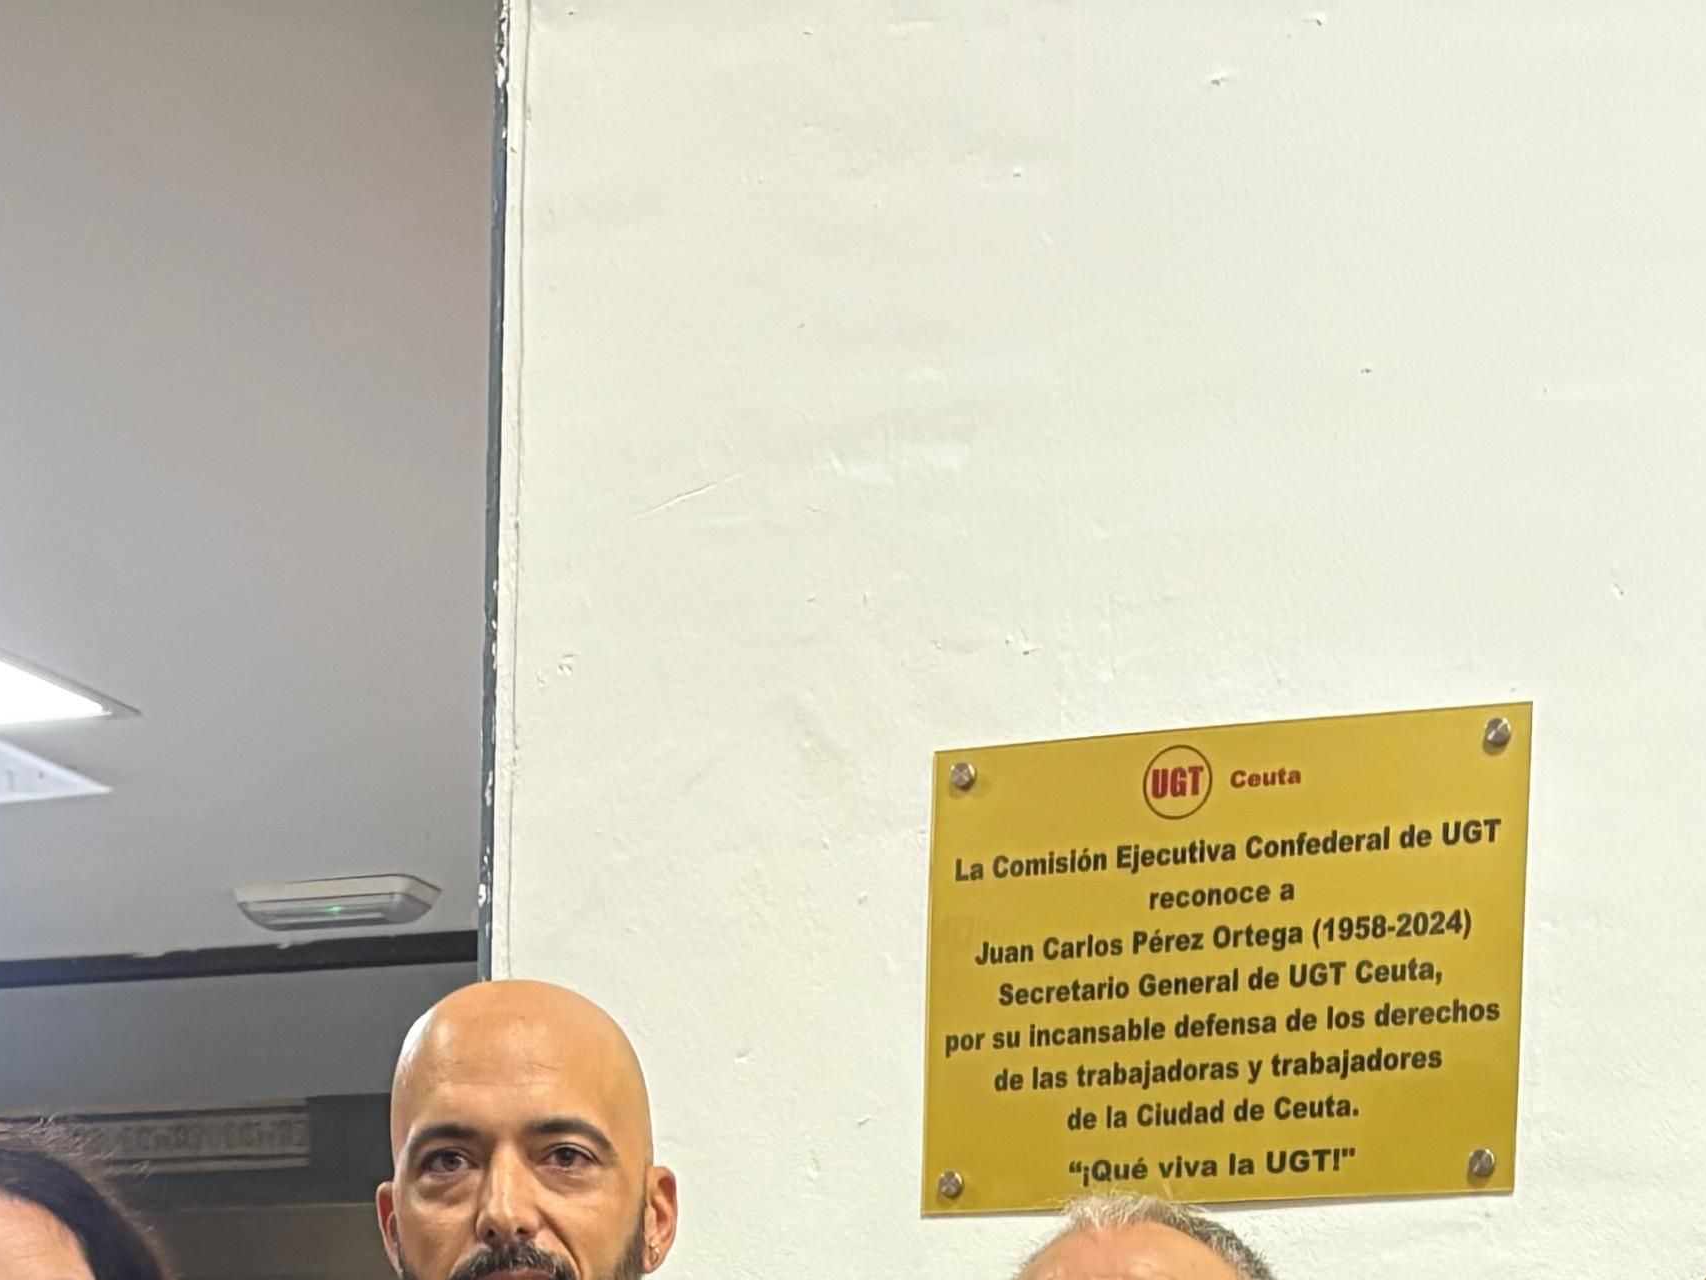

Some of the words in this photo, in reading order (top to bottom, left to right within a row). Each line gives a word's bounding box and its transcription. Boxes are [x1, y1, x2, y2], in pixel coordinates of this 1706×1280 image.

[1150, 766, 1203, 800] UGT
[1230, 767, 1301, 789] Ceuta
[955, 858, 983, 881] La
[993, 848, 1107, 878] Comisión
[1116, 840, 1236, 873] Ejecutiva
[1246, 826, 1390, 859] Confederal
[1400, 824, 1432, 848] de
[1443, 819, 1501, 845] UGT
[1149, 883, 1270, 910] reconoce
[1280, 882, 1295, 900] a
[975, 942, 1033, 965] Juan
[1043, 934, 1122, 960] Carlos
[1132, 930, 1204, 954] Pérez
[1213, 925, 1303, 951] Ortega
[1312, 908, 1472, 948] (1958-2024)
[998, 976, 1129, 1006] Secretario
[1138, 968, 1239, 997] General
[1248, 966, 1279, 991] de
[1289, 962, 1346, 988] UGT
[1356, 958, 1442, 985] Ceuta,
[945, 1033, 985, 1058] por
[993, 1030, 1020, 1050] su
[1029, 1016, 1166, 1047] incansable
[1174, 1013, 1276, 1039] defensa
[1286, 1008, 1317, 1032] de
[1327, 1006, 1365, 1029] los
[1375, 999, 1500, 1027] derechos
[994, 1069, 1023, 1091] de
[1033, 1067, 1067, 1089] las
[1077, 1058, 1239, 1090] trabajadoras
[1248, 1060, 1262, 1084] y
[1271, 1047, 1443, 1080] trabajadores
[1067, 1107, 1097, 1130] de
[1107, 1105, 1127, 1128] la
[1137, 1100, 1224, 1127] Ciudad
[1234, 1099, 1264, 1122] de
[1274, 1096, 1359, 1120] Ceuta.
[1159, 1155, 1217, 1178] viva
[1229, 1153, 1254, 1176] la
